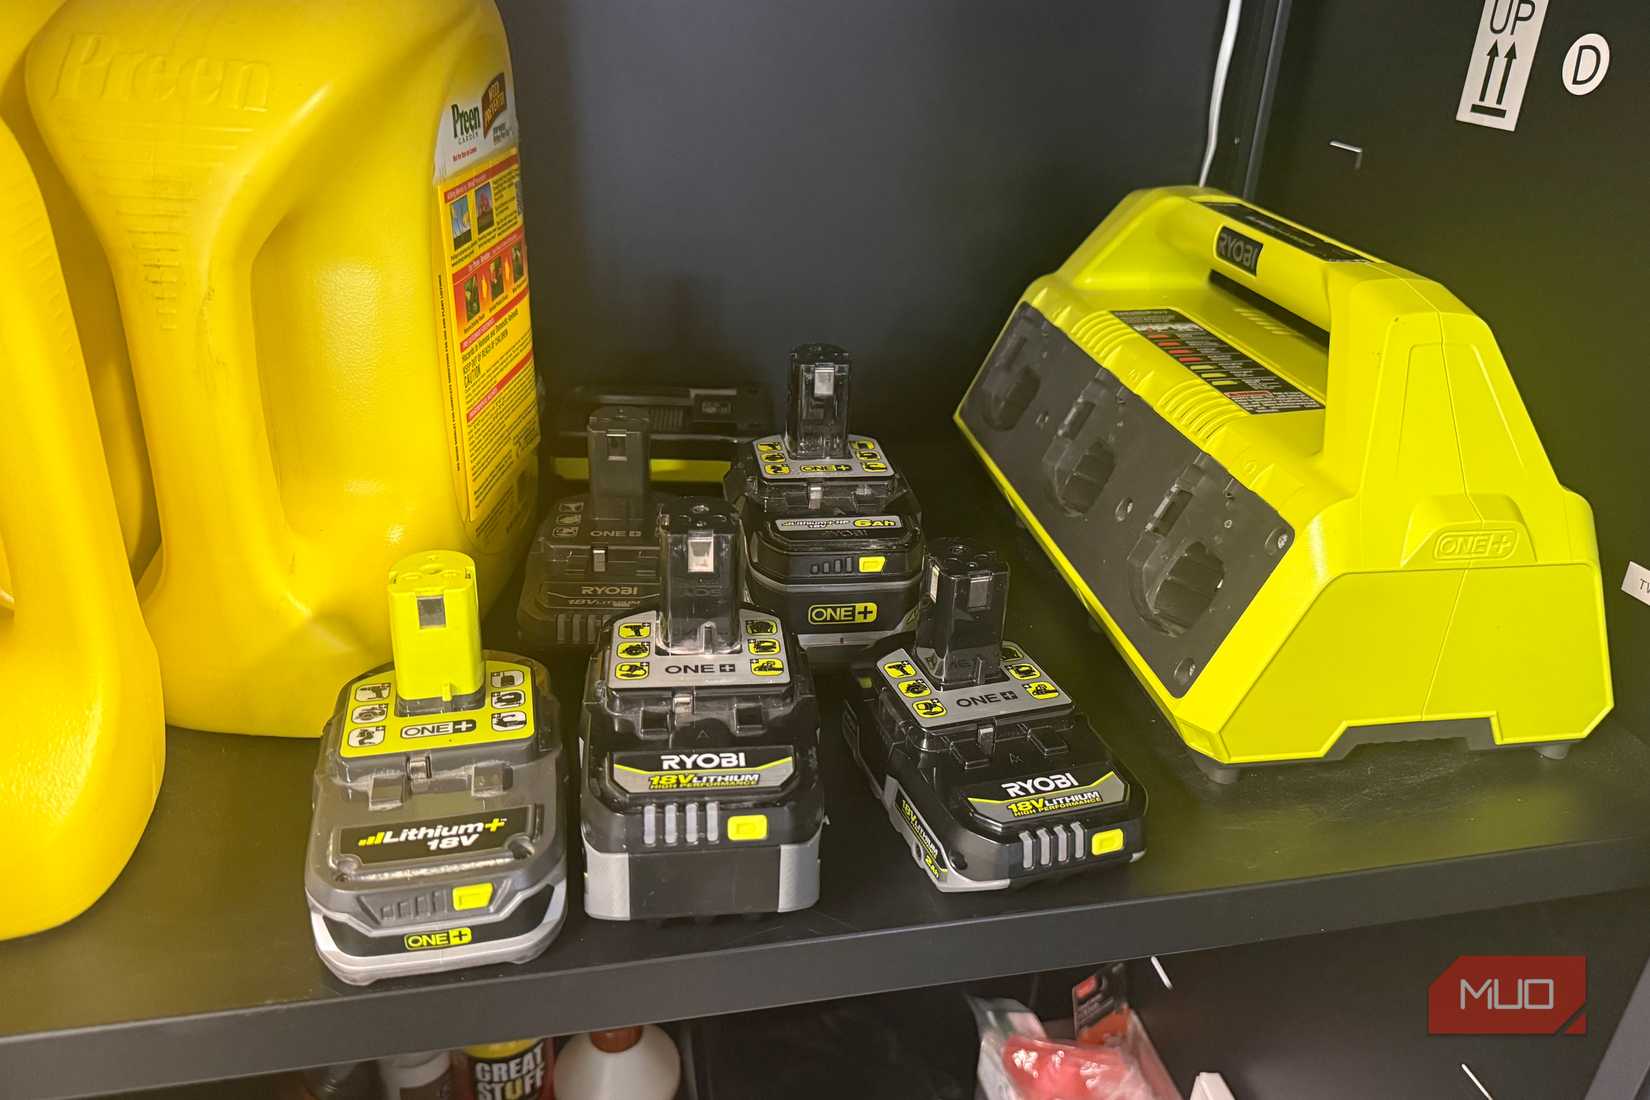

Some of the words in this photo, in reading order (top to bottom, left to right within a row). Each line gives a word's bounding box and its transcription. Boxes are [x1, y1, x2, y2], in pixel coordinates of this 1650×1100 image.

[1490, 0, 1536, 35] UP
[50, 31, 272, 112] Preen
[1571, 44, 1602, 85] D
[451, 103, 481, 139] Preen
[1218, 233, 1259, 271] RYOBI
[853, 519, 897, 528] 6Ah
[581, 586, 638, 595] RYOBI
[660, 752, 746, 770] RYOBI
[1001, 772, 1079, 797] RYOBI
[1014, 808, 1036, 817] HIGH
[1038, 797, 1102, 813] PERFORMANCE
[427, 834, 480, 850] 18V
[925, 854, 939, 878] 2Ah
[475, 1041, 545, 1082] GREAT
[477, 1063, 545, 1100] STUFF
